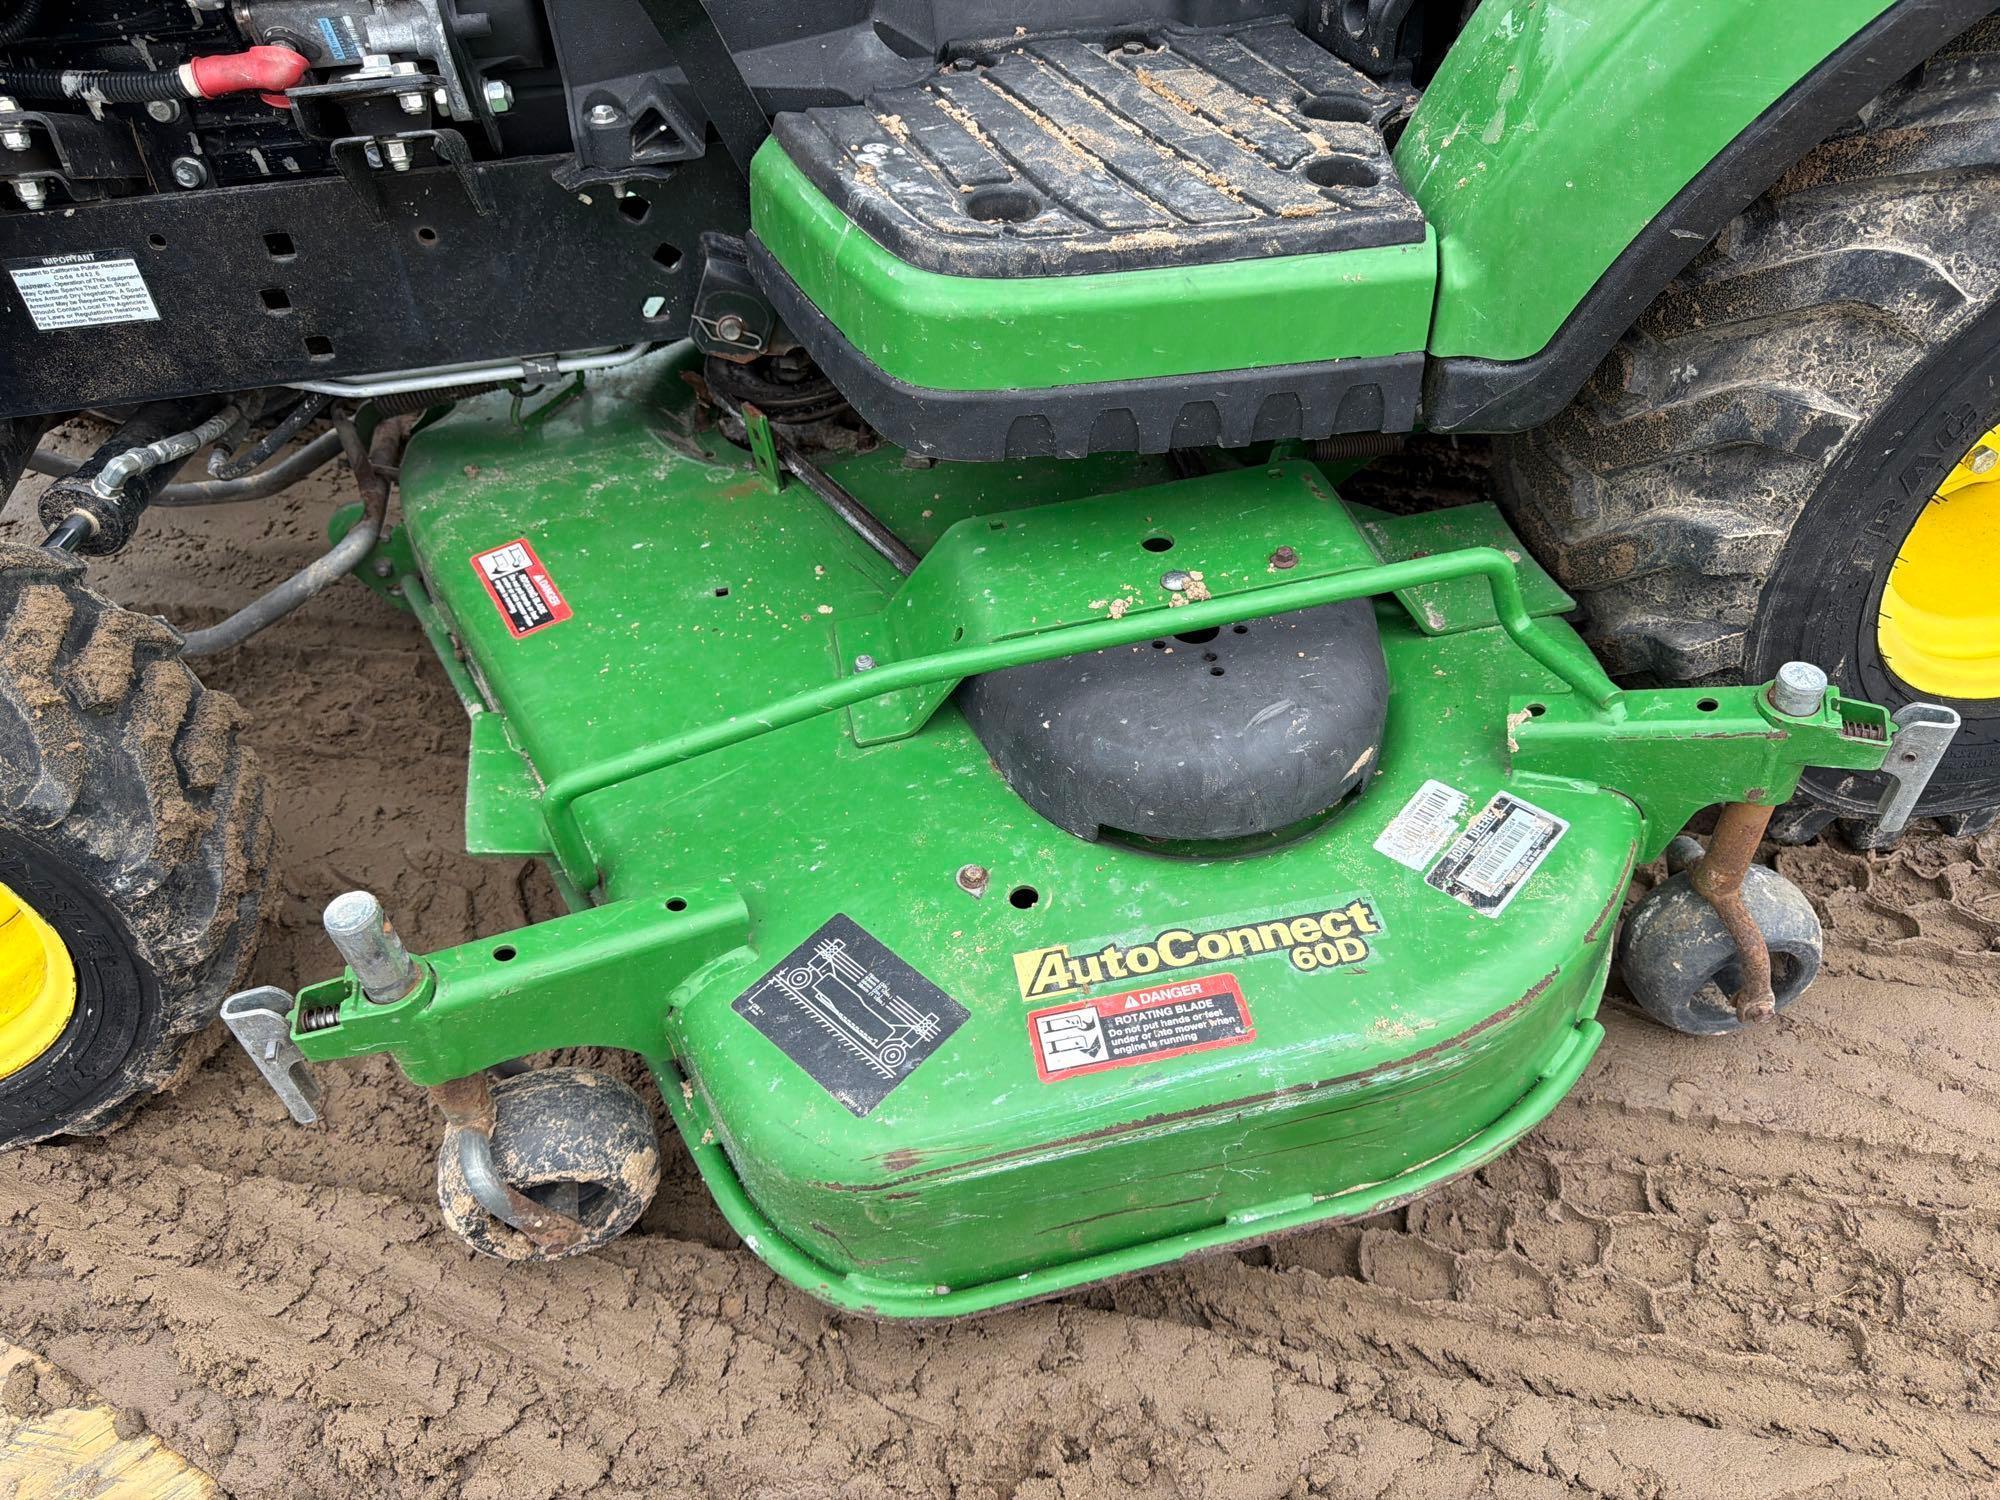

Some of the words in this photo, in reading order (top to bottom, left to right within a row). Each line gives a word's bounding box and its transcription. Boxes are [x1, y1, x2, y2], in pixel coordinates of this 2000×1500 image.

[41, 253, 96, 265] IMPORTANT
[99, 260, 134, 268] Resources
[106, 273, 140, 282] Equipment
[59, 285, 84, 293] Sparks
[124, 285, 144, 293] Spark
[119, 292, 148, 300] Operator
[115, 299, 147, 307] Agencies
[74, 309, 114, 318] Regulations
[51, 317, 87, 326] Prevention
[1447, 837, 1473, 862] JOHN
[1028, 900, 1379, 996] AutoConnect
[1291, 937, 1368, 971] 60D
[1140, 983, 1203, 1004] DANGER
[1114, 1006, 1173, 1025] ROTATING
[1175, 998, 1214, 1013] BLADE
[1108, 1027, 1123, 1037] Do
[1124, 1024, 1141, 1034] not
[1142, 1020, 1159, 1032] put
[1160, 1014, 1191, 1027] hands
[1192, 1013, 1203, 1021] or
[1203, 1008, 1223, 1018] feet
[1111, 1034, 1139, 1046] under
[1141, 1032, 1152, 1040] or
[1153, 1027, 1173, 1037] into
[1174, 1021, 1207, 1033] mower
[1208, 1014, 1235, 1027] when
[1112, 1041, 1147, 1056] engine
[1147, 1038, 1158, 1048] is
[1158, 1030, 1197, 1047] running
